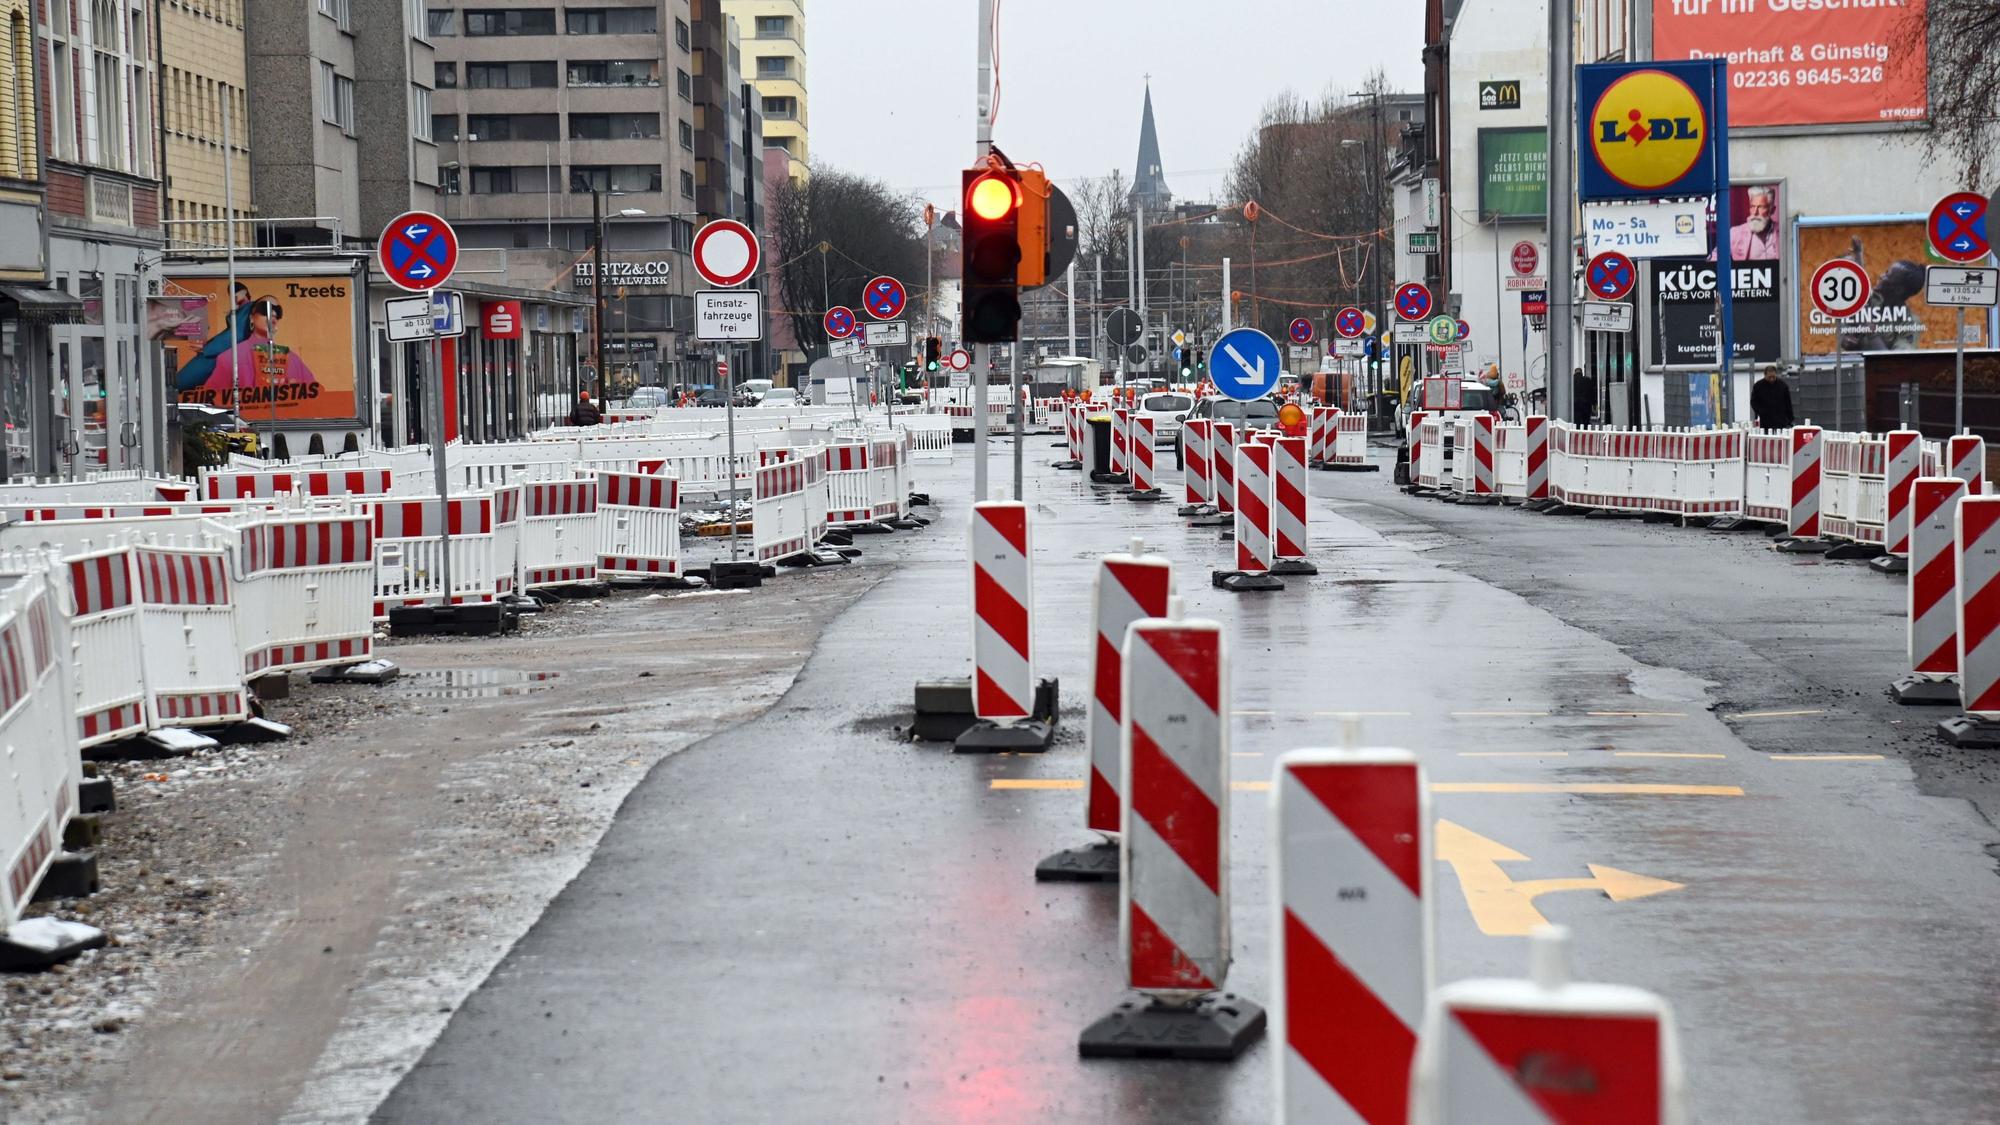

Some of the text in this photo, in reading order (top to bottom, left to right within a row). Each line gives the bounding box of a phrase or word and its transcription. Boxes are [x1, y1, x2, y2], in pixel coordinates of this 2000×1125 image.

[1790, 46, 1804, 61] &
[1810, 43, 1888, 61] Günstig
[1733, 66, 1883, 88] 02236 9645-326
[1525, 162, 1547, 171] BIENE
[1593, 219, 1614, 230] Mo
[1630, 217, 1647, 228] Sa
[1593, 235, 1600, 246] 7
[1616, 234, 1630, 245] 21
[1635, 232, 1660, 244] Uhr
[576, 261, 669, 276] HRTZ&CO
[576, 276, 668, 288] HOPTALWERK
[1507, 279, 1544, 288] ROBIN HOOD
[286, 283, 346, 298] Treets
[1690, 289, 1711, 300] VOR
[1731, 289, 1772, 299] METERN.
[1823, 276, 1858, 302] 30
[707, 299, 748, 308] Einsatz-
[1528, 293, 1543, 302] sky
[703, 311, 752, 322] fahrzeuge
[1809, 306, 1913, 325] GEINSAM.
[404, 319, 431, 328] ab 13.0
[720, 323, 737, 332] frei
[1810, 326, 1837, 335] Hunger
[1874, 323, 1893, 333] Jetzt
[1895, 322, 1928, 333] spenden.
[1678, 341, 1755, 353] kuecheft.de
[181, 385, 217, 405] FÜR
